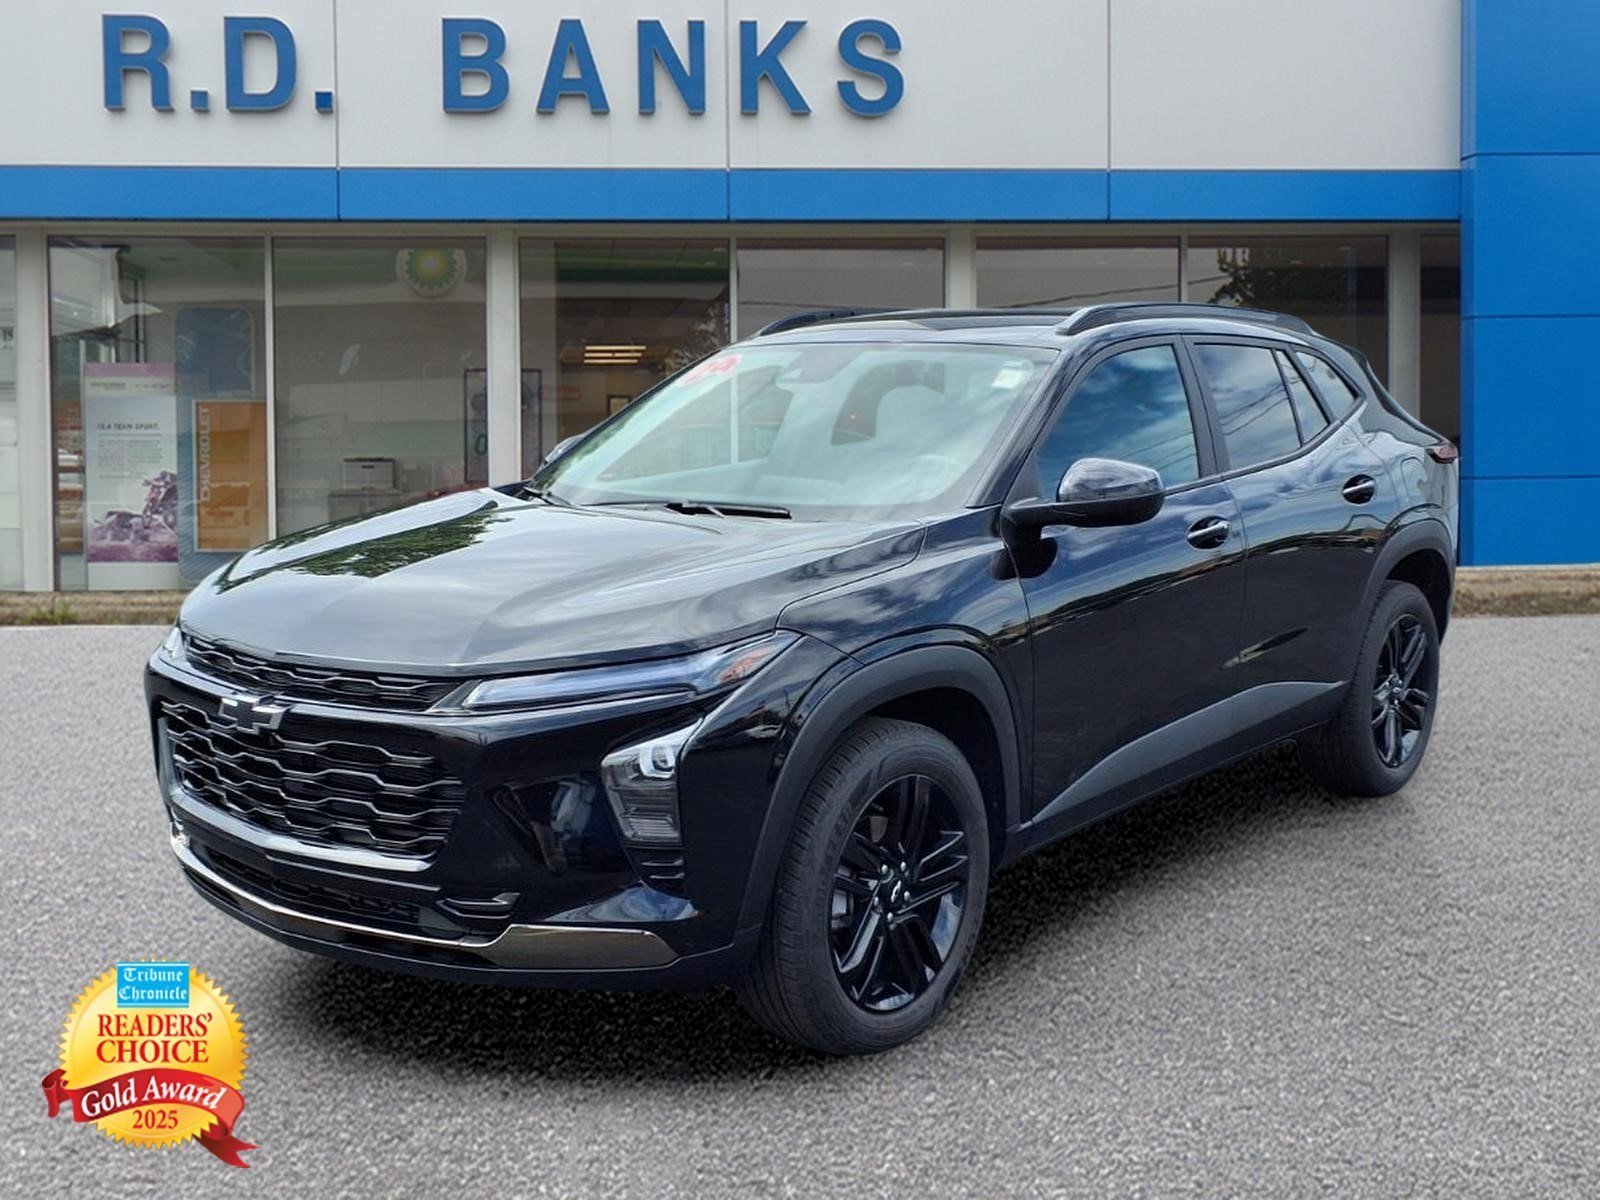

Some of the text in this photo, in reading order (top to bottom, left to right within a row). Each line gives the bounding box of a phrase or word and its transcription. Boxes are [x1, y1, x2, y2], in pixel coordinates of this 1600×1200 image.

[101, 13, 906, 118] R.D. BANKS
[200, 405, 210, 502] CHEVROLET
